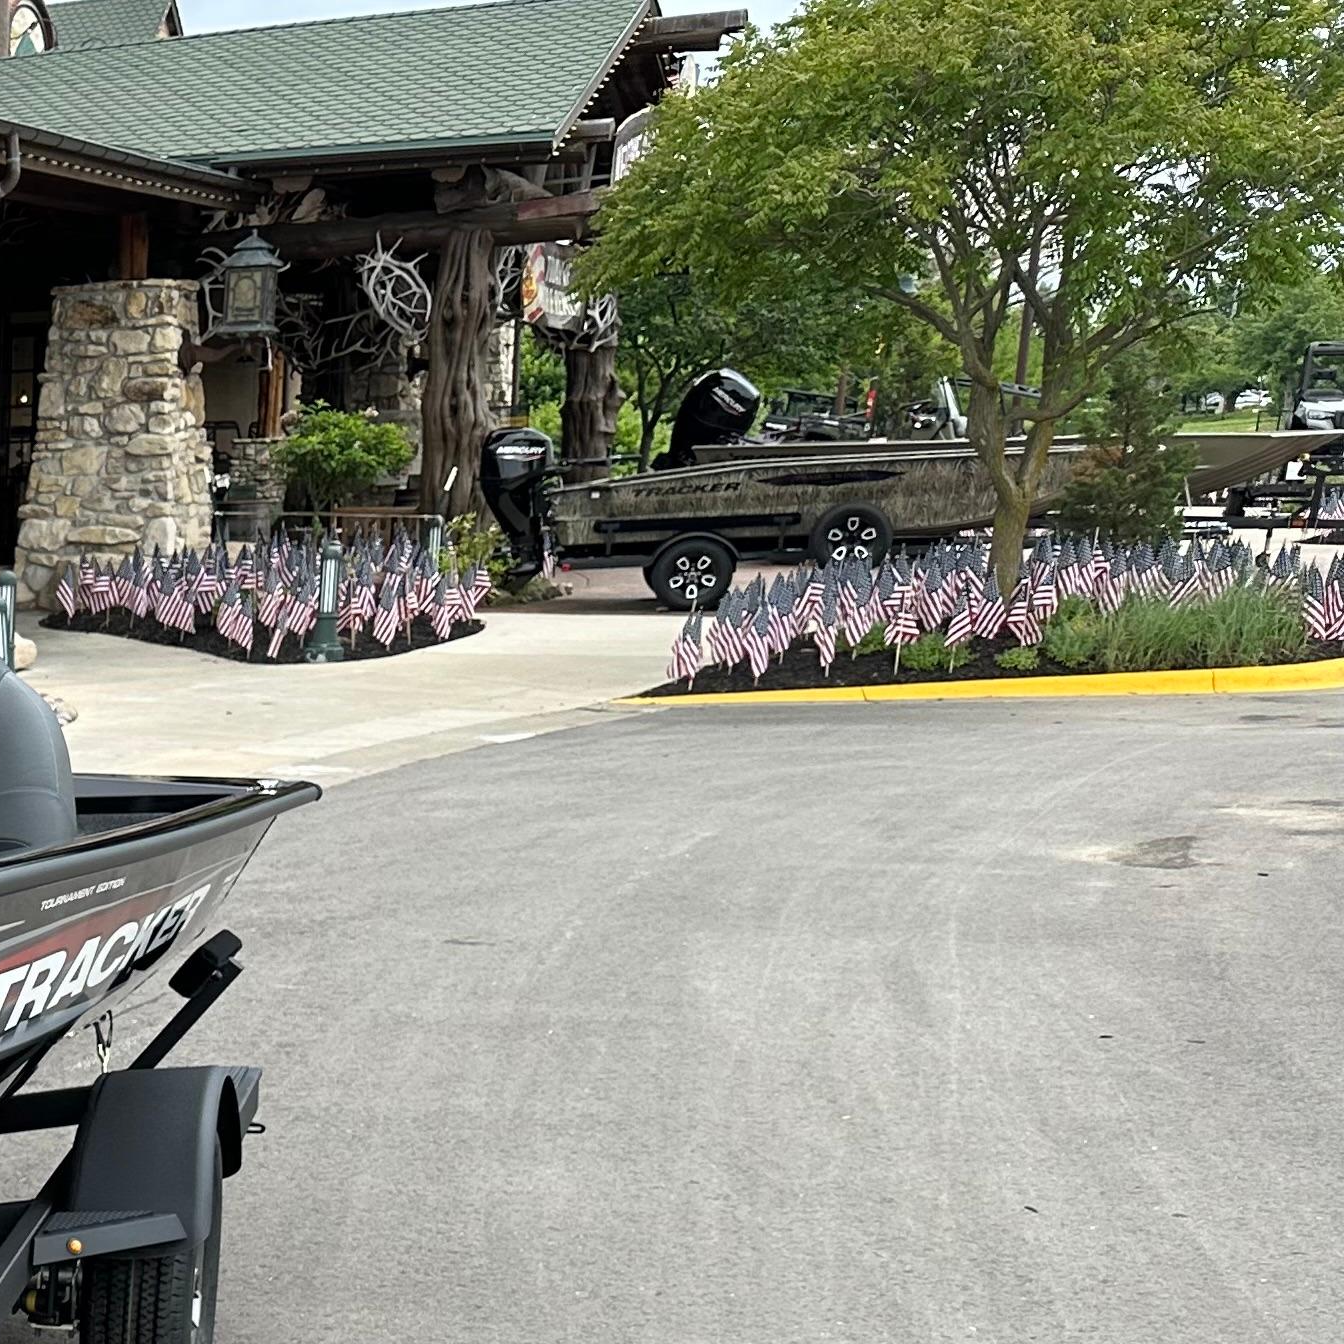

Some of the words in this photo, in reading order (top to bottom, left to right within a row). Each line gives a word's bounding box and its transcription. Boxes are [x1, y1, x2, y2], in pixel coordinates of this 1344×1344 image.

[633, 482, 741, 497] TRACKER
[40, 885, 97, 912] TOURNAMENT
[95, 876, 127, 894] EDITION
